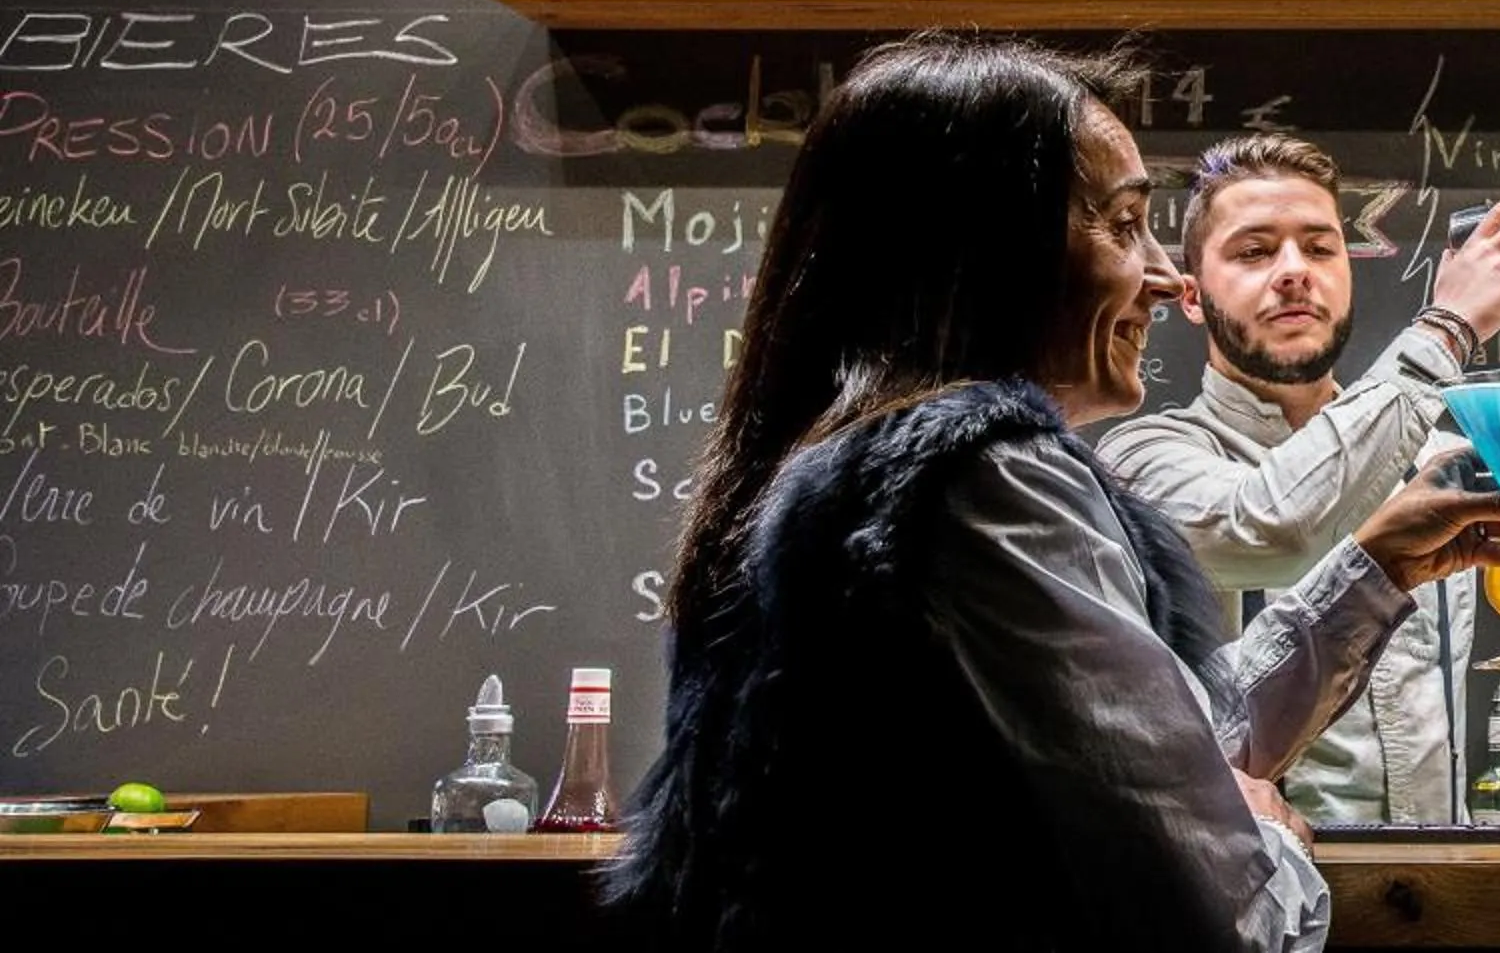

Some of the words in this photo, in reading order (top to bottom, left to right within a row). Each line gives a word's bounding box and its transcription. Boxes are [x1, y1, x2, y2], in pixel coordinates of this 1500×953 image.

[0, 12, 459, 74] BIERES
[0, 173, 137, 229] eineken
[620, 323, 672, 374] El
[416, 342, 527, 436] Bud
[210, 484, 273, 533] vin
